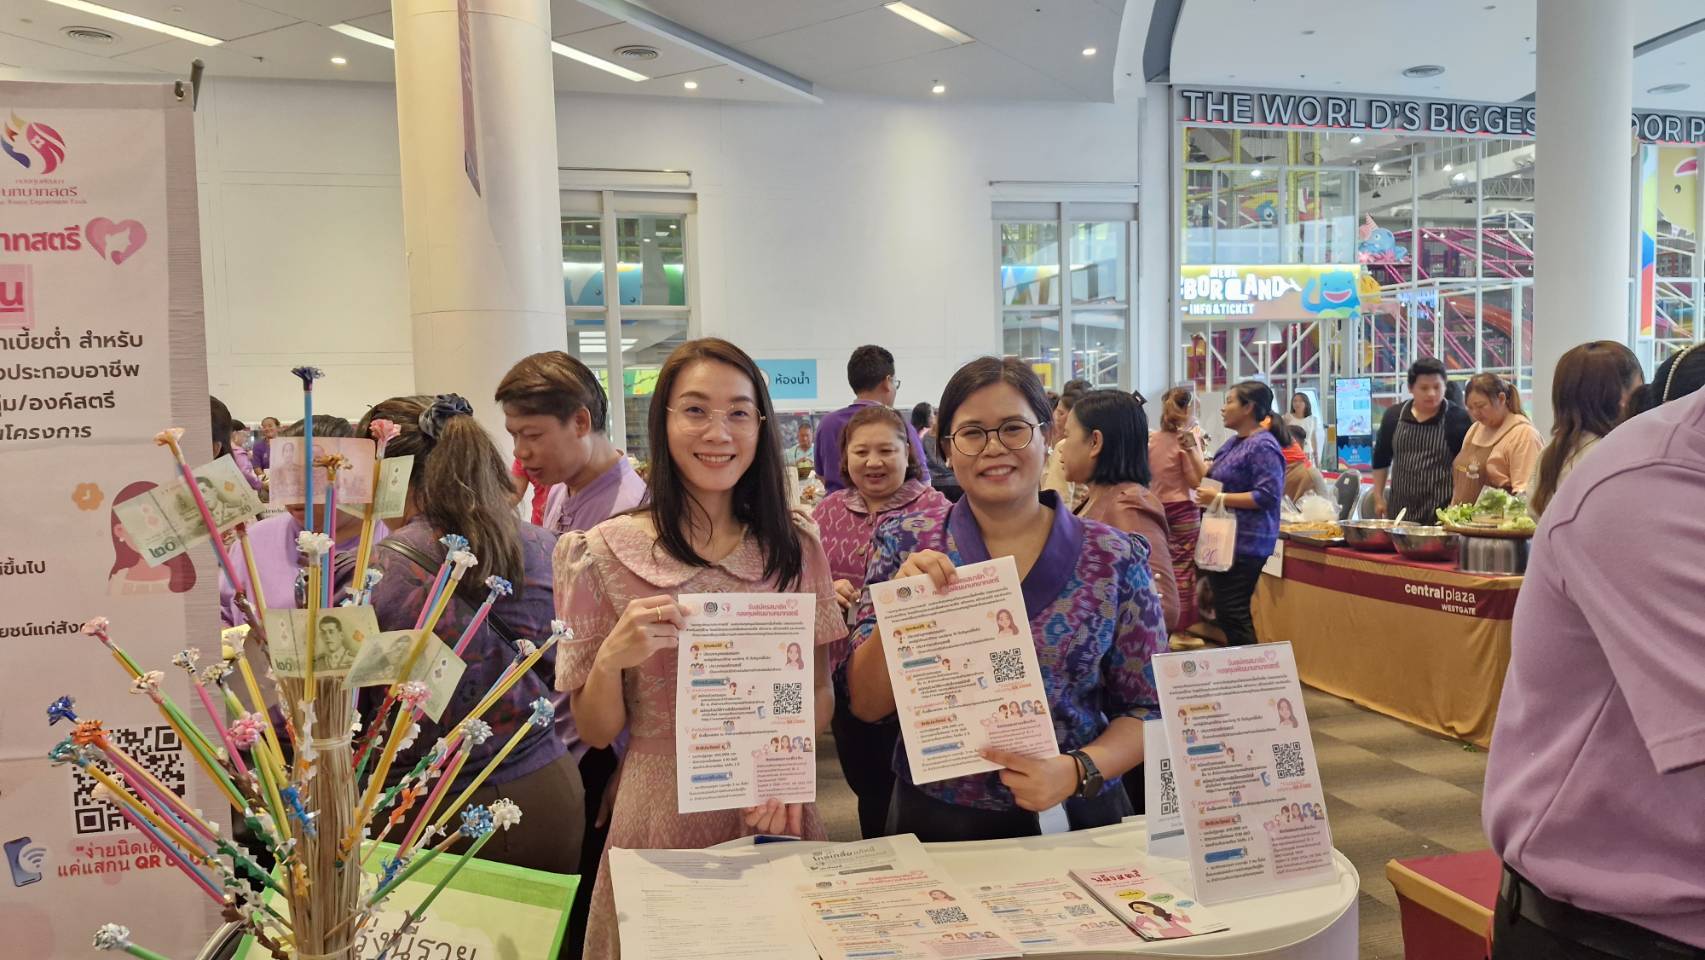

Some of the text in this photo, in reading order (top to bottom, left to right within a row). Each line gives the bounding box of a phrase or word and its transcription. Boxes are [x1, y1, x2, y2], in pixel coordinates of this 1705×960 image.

[1181, 90, 1251, 122] THE
[1260, 95, 1422, 131] WORLD'S
[80, 329, 144, 348] สำหรับ
[775, 370, 810, 385] ห้องน้ำ
[0, 390, 116, 417] ม/องค์สตรี
[0, 424, 92, 440] โครงการ
[1441, 603, 1477, 616] WESTGATE
[58, 857, 131, 877] แค่แสกน
[135, 854, 161, 870] QR
